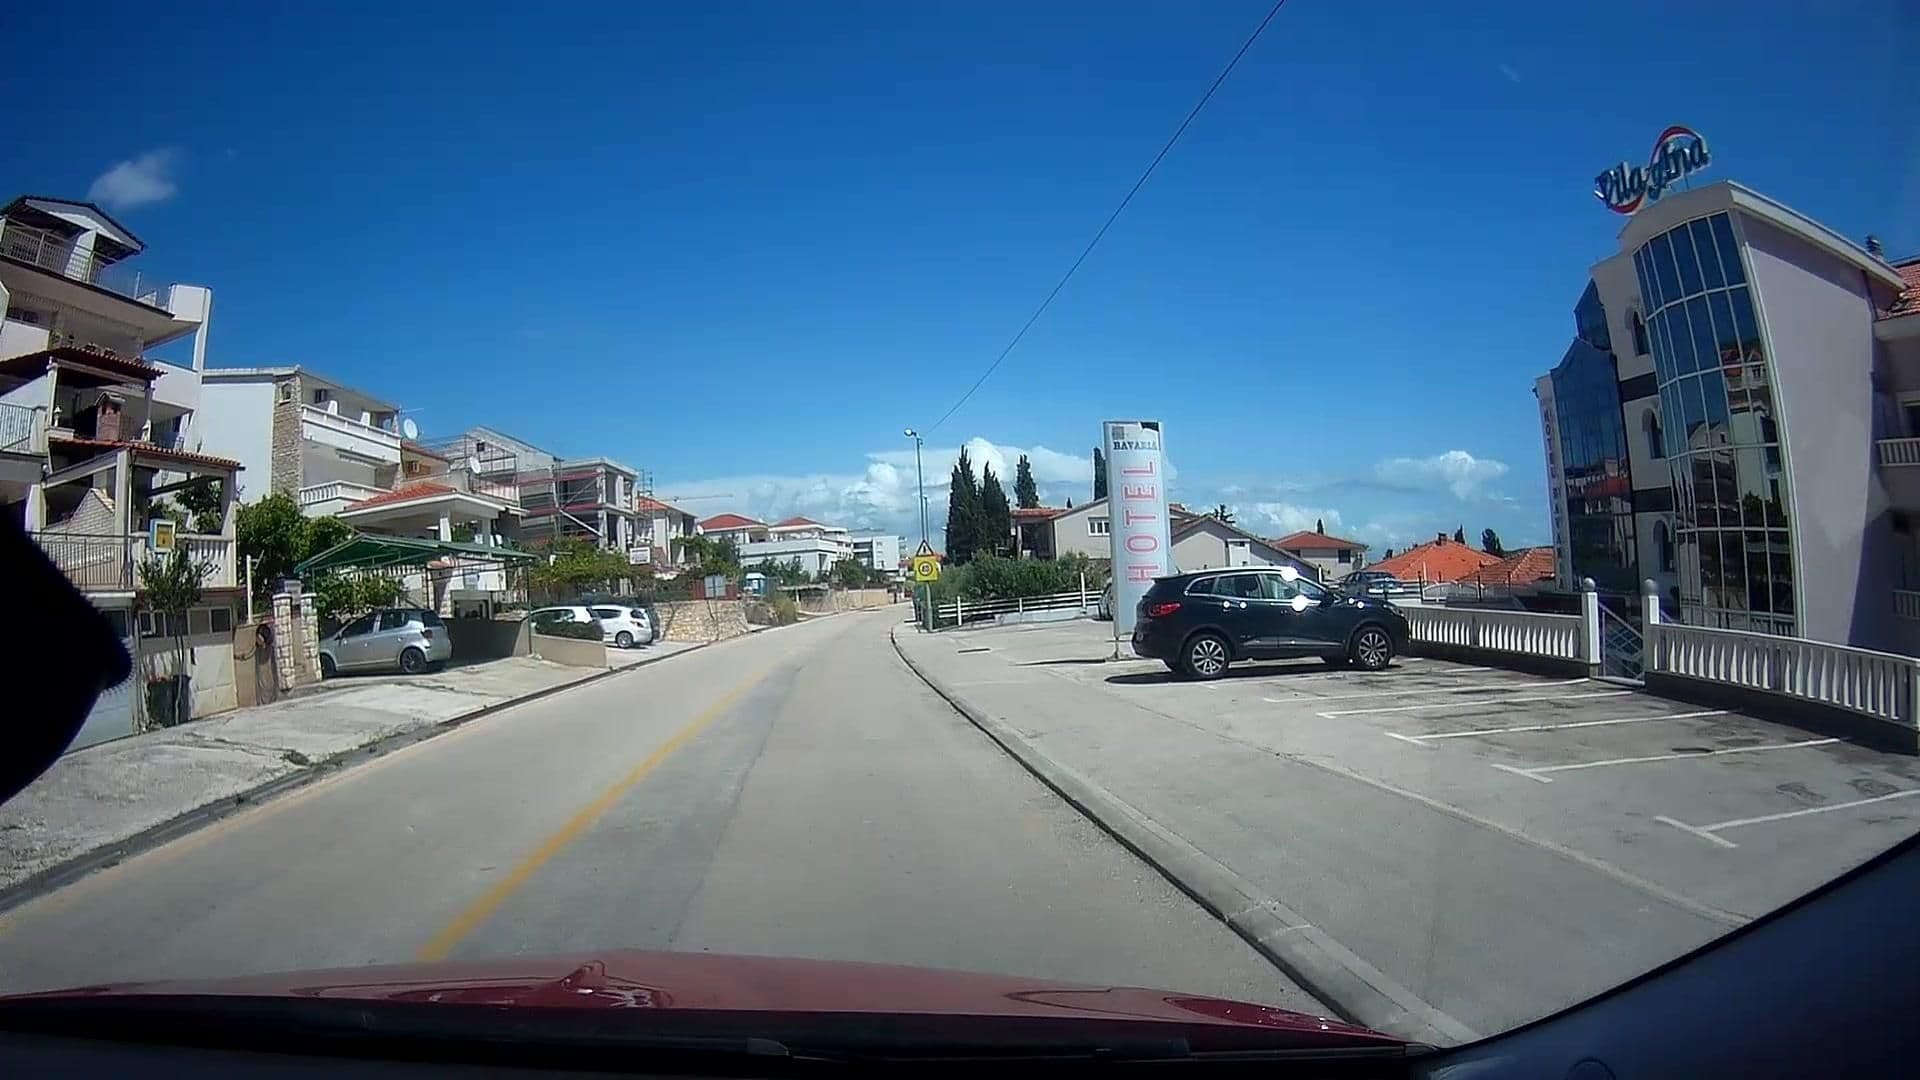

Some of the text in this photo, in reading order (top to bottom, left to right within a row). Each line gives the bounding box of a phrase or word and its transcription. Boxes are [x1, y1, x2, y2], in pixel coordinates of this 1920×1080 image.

[1595, 138, 1711, 208] Vila Ana
[1113, 441, 1158, 450] BAVARIA
[1543, 408, 1556, 478] HOTEL
[1122, 460, 1159, 583] HOTEL
